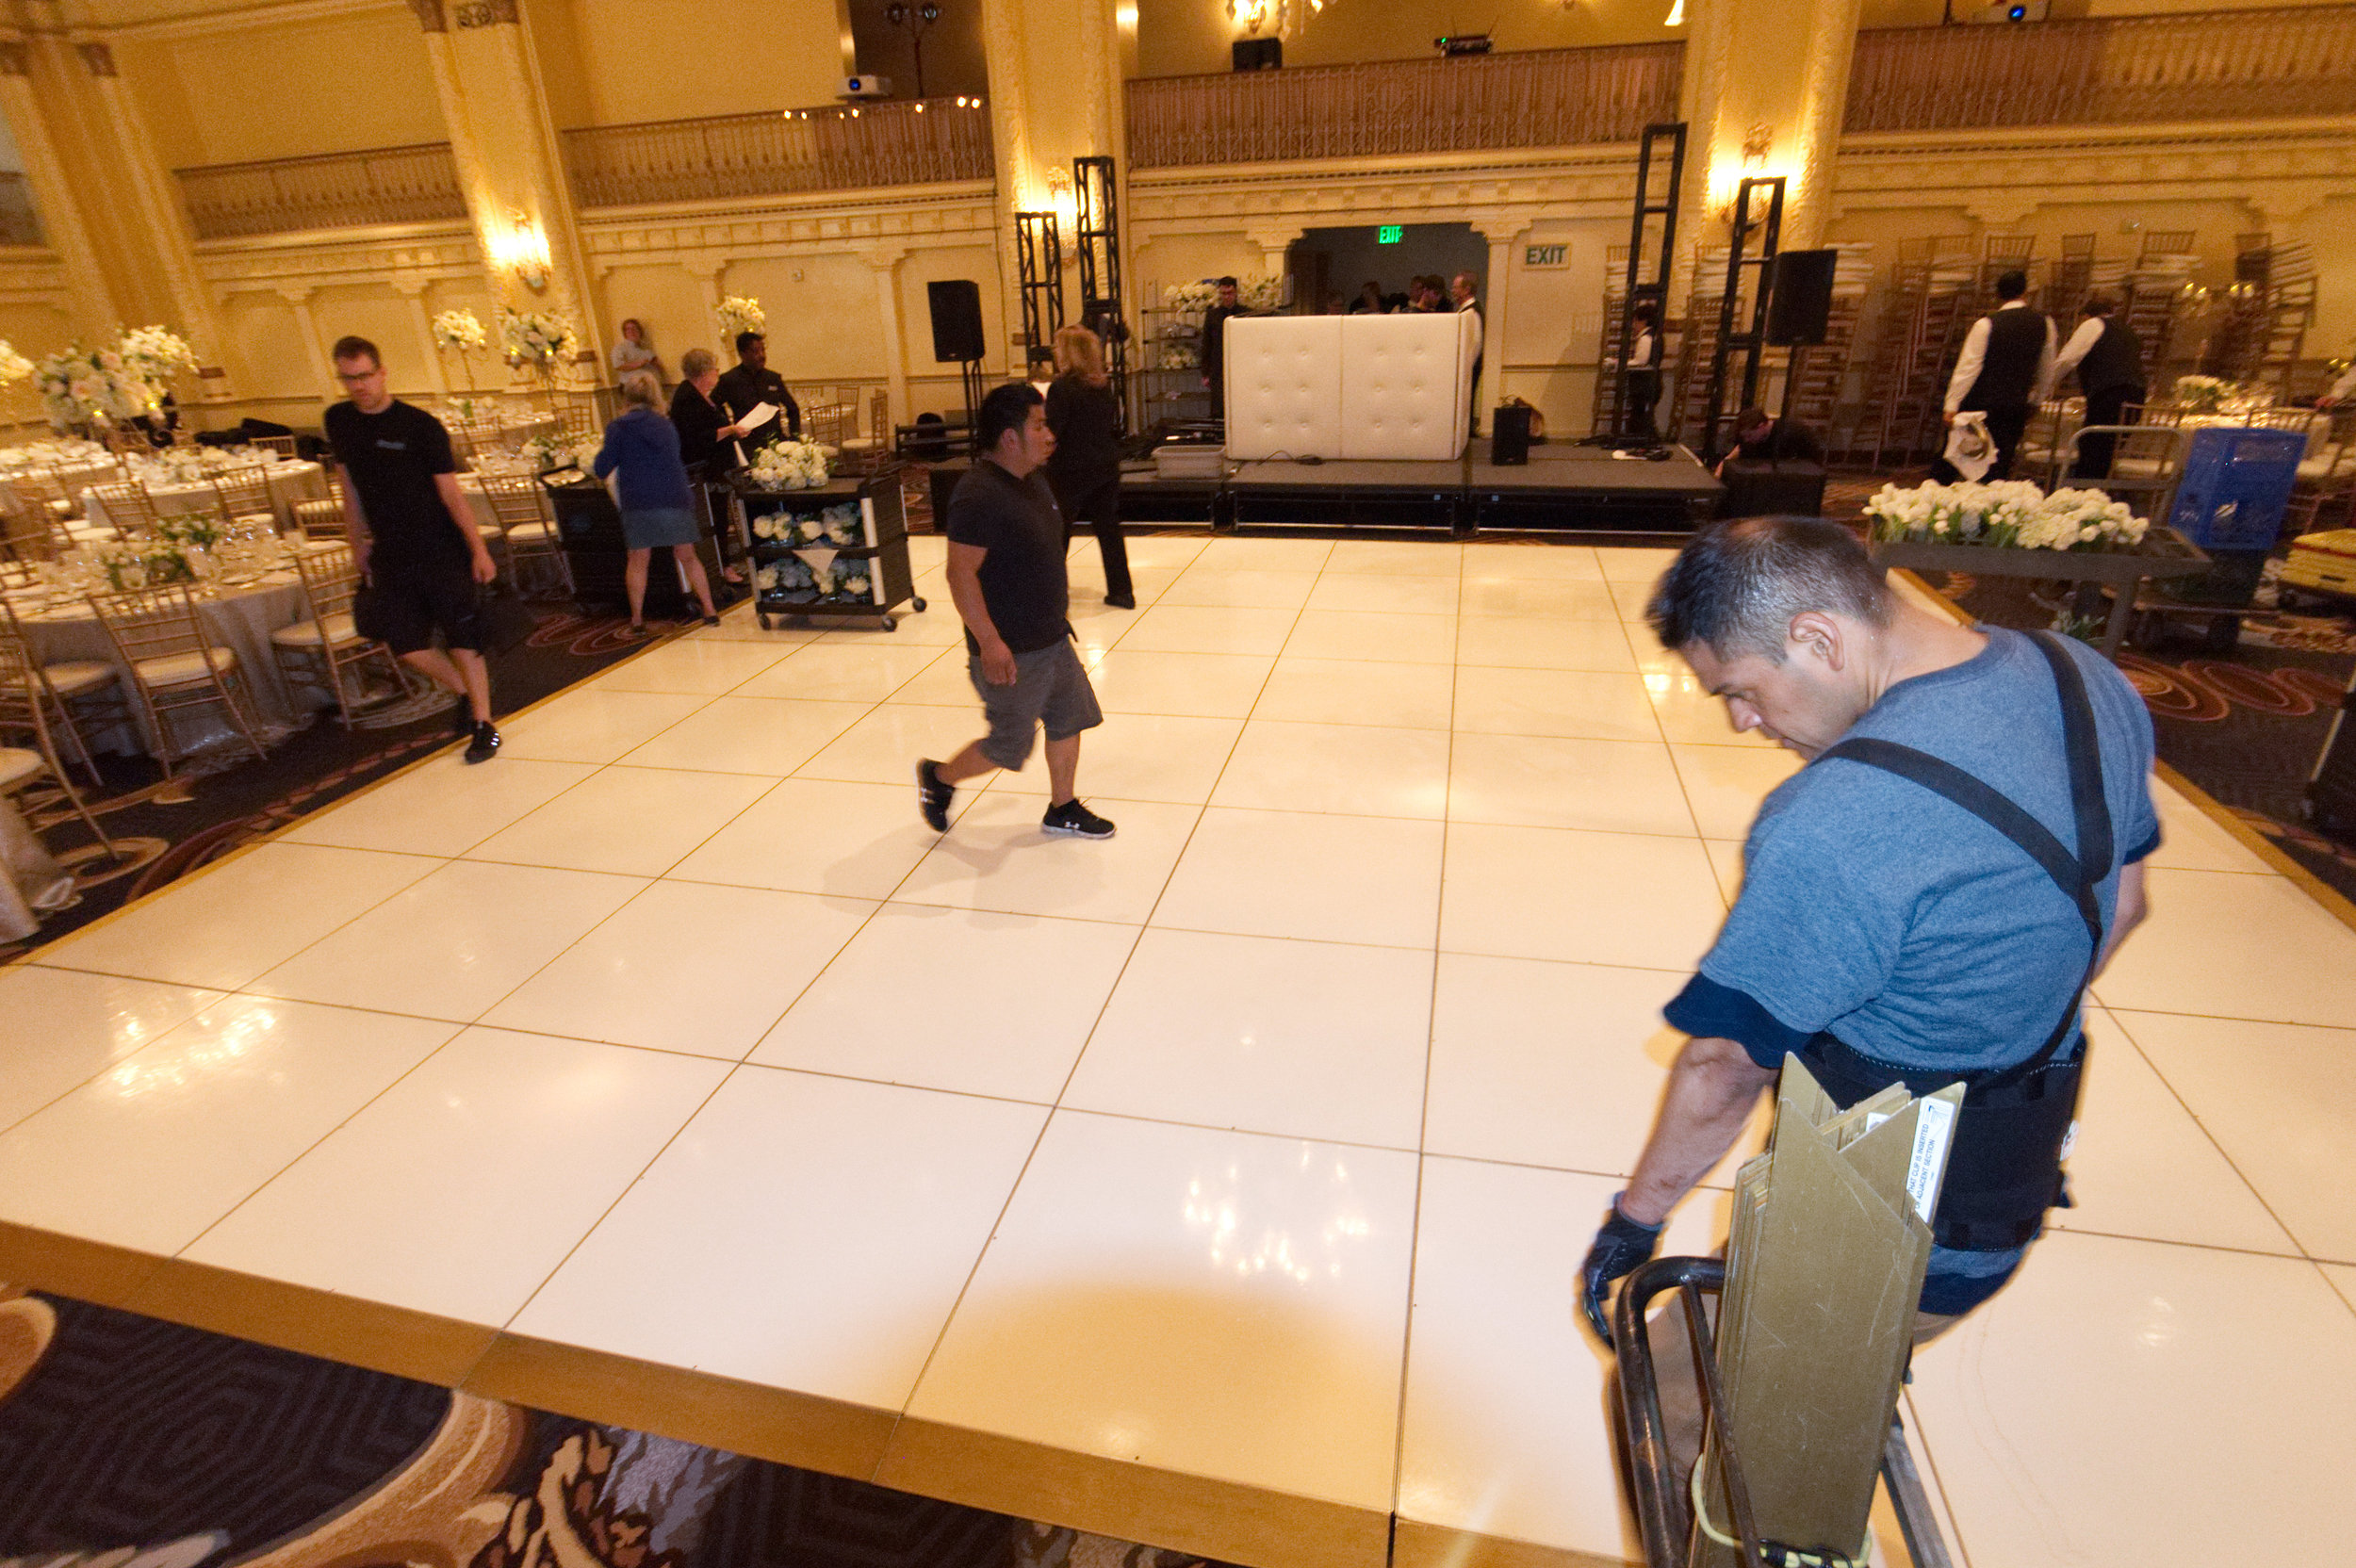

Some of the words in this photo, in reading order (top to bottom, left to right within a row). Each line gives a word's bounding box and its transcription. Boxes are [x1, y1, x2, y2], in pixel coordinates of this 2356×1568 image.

[1379, 225, 1401, 244] EXIT
[1526, 245, 1567, 265] EXIT
[1908, 1177, 1917, 1192] THAT
[1917, 1123, 1929, 1154] INSERTED
[1917, 1167, 1929, 1200] ADJACENT
[1923, 1138, 1936, 1166] SECTION
